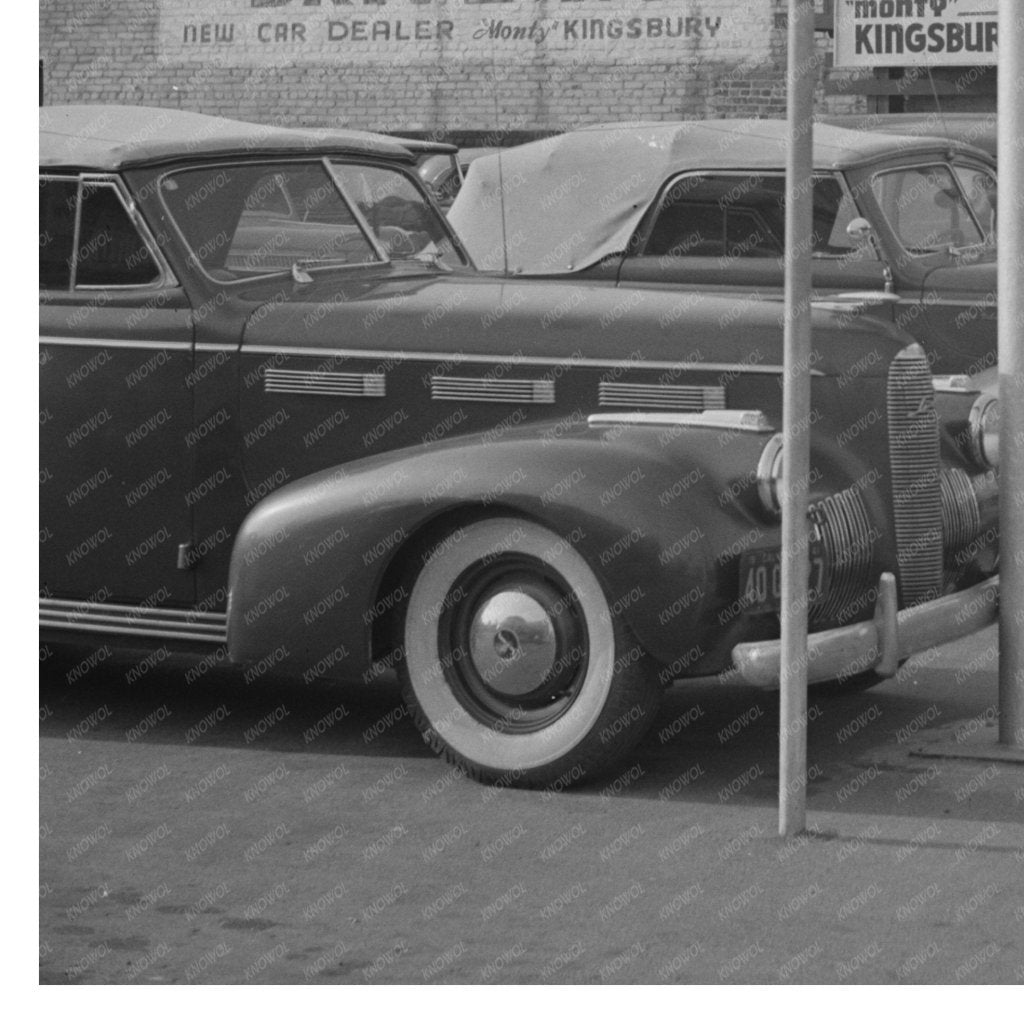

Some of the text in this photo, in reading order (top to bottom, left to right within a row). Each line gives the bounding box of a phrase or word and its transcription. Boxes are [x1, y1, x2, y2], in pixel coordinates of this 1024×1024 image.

[183, 23, 235, 44] NEW
[257, 22, 307, 43] CAR
[327, 19, 455, 42] DEALER
[563, 17, 722, 41] KINGSBURY
[855, 22, 999, 55] KINGSBUR
